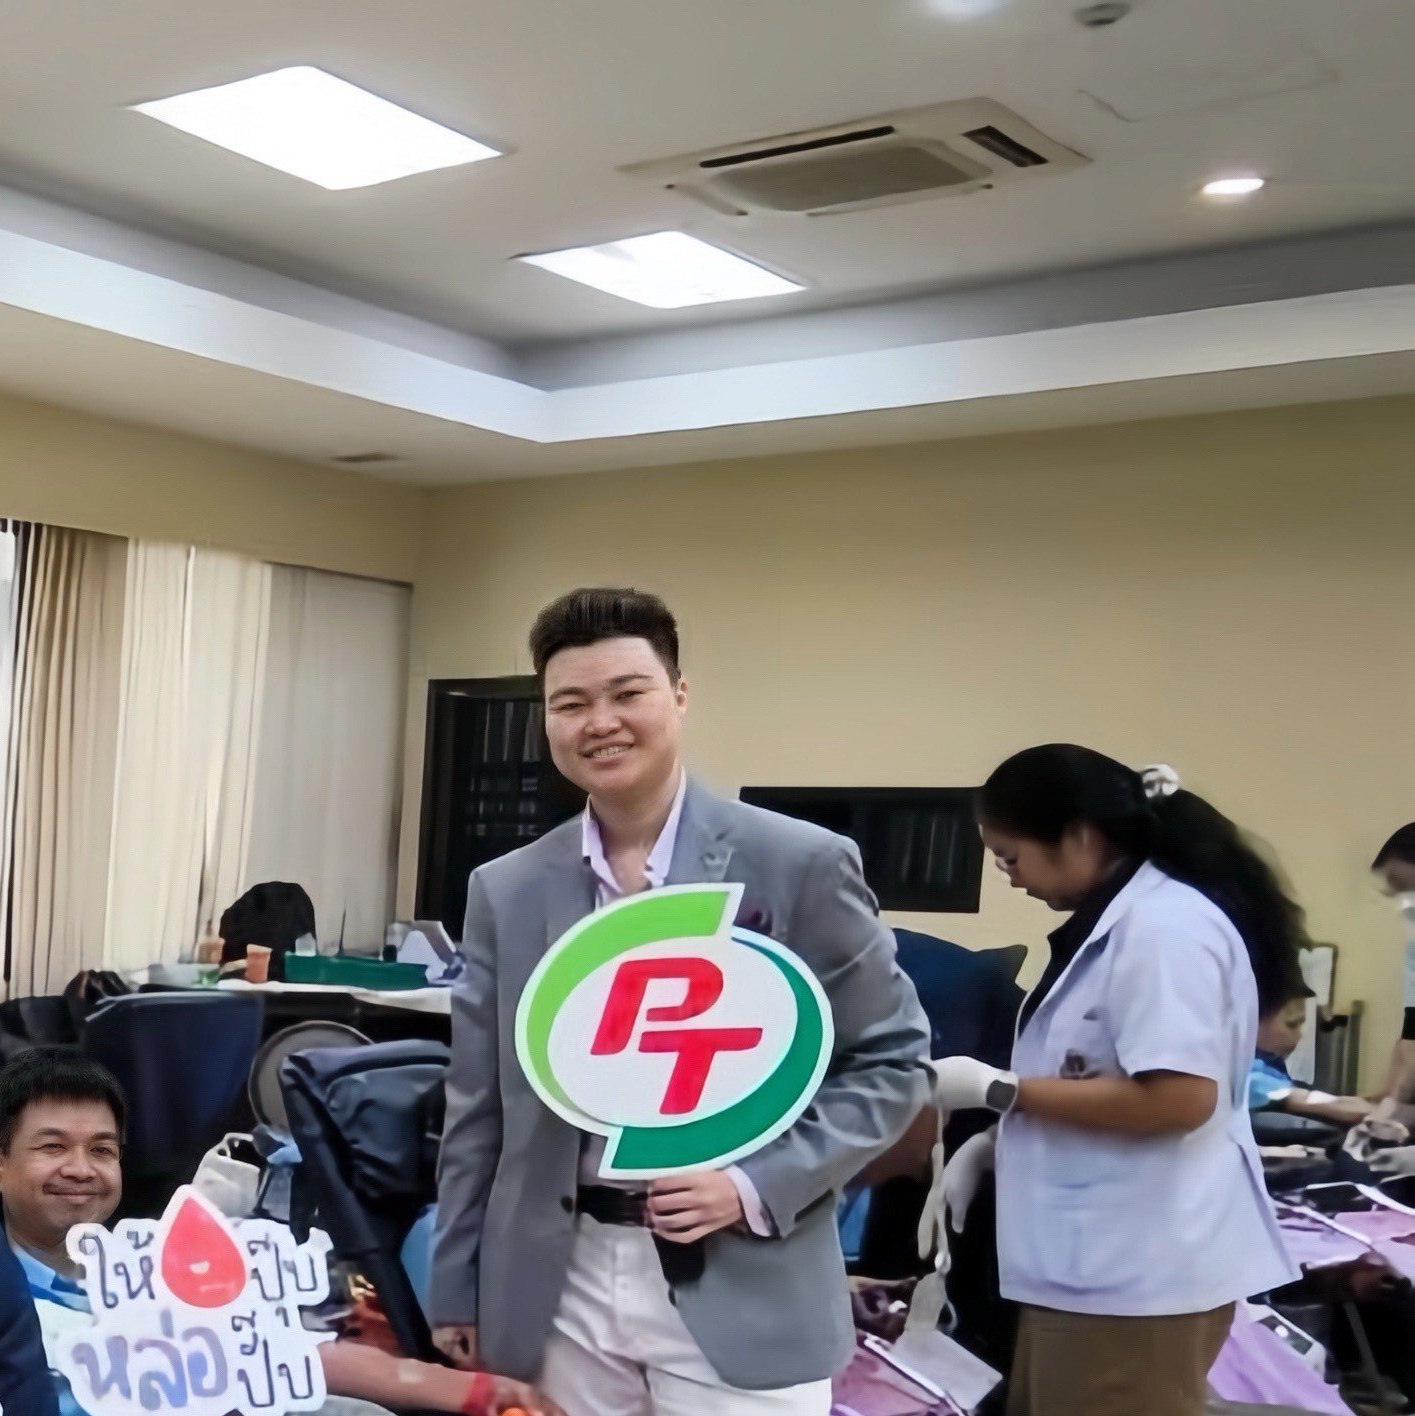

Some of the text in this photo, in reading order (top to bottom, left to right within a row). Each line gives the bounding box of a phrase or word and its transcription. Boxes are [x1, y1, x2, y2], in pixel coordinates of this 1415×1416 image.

[590, 957, 764, 1115] PT
[77, 1230, 156, 1310] ให้
[71, 1308, 229, 1411] หล่อ
